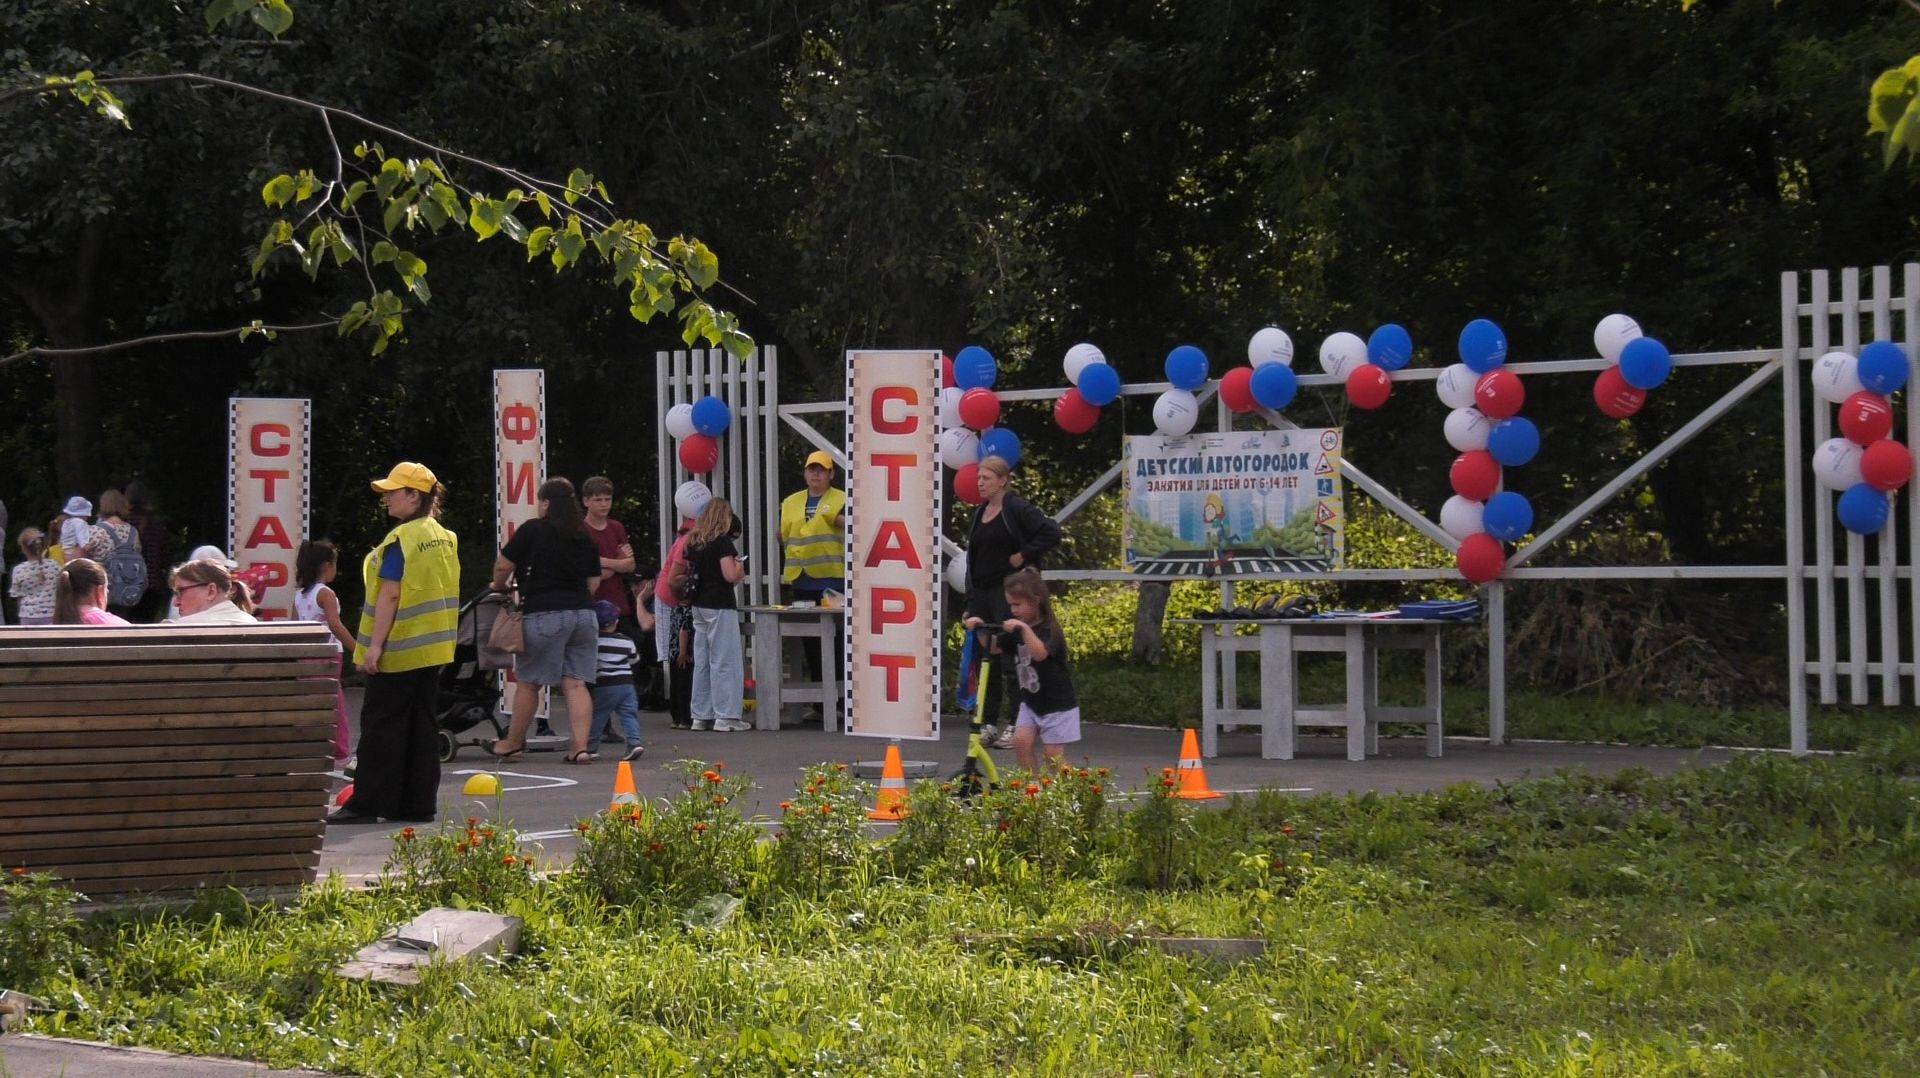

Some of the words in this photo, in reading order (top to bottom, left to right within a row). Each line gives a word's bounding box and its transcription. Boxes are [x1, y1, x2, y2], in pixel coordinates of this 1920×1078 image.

[1206, 452, 1310, 474] АВТОГОРОДОК
[1147, 478, 1193, 493] ЗАНЯТИЯ
[1212, 475, 1240, 491] ДЕТЕЙ
[1243, 477, 1257, 490] ОТ
[1259, 477, 1280, 489] 6-14
[1282, 476, 1299, 489] ЛЕТ
[864, 386, 922, 702] СТАРТ
